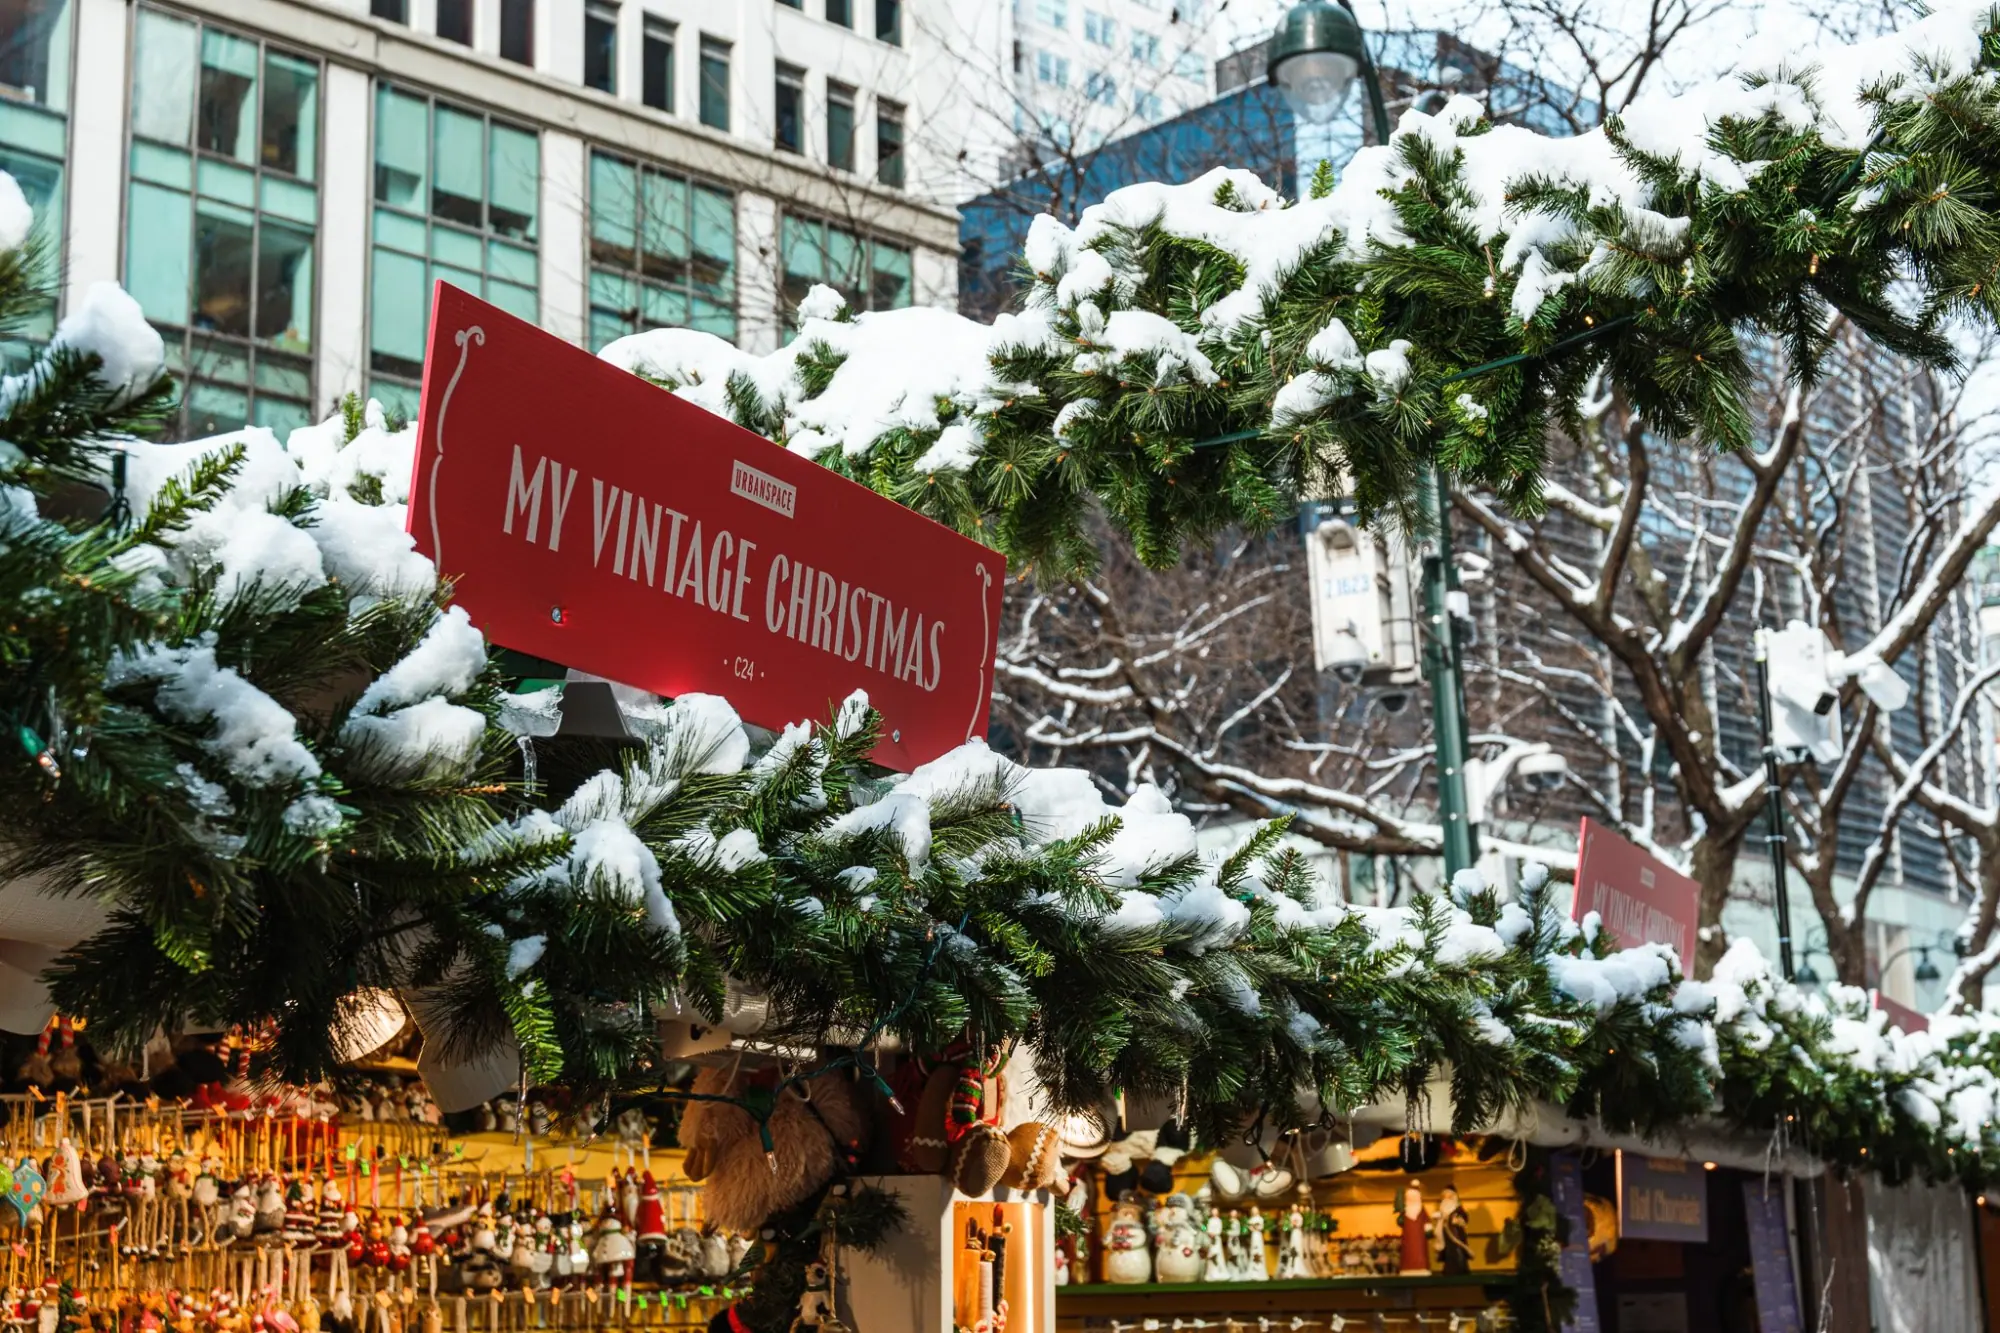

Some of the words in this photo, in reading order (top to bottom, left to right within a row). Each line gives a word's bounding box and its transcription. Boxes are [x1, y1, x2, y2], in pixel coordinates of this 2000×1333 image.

[735, 468, 793, 511] URBANSPACE
[503, 444, 578, 552] MY
[592, 476, 757, 623] VINTAGE
[765, 554, 945, 692] CHRISTMAS
[735, 656, 754, 681] C24
